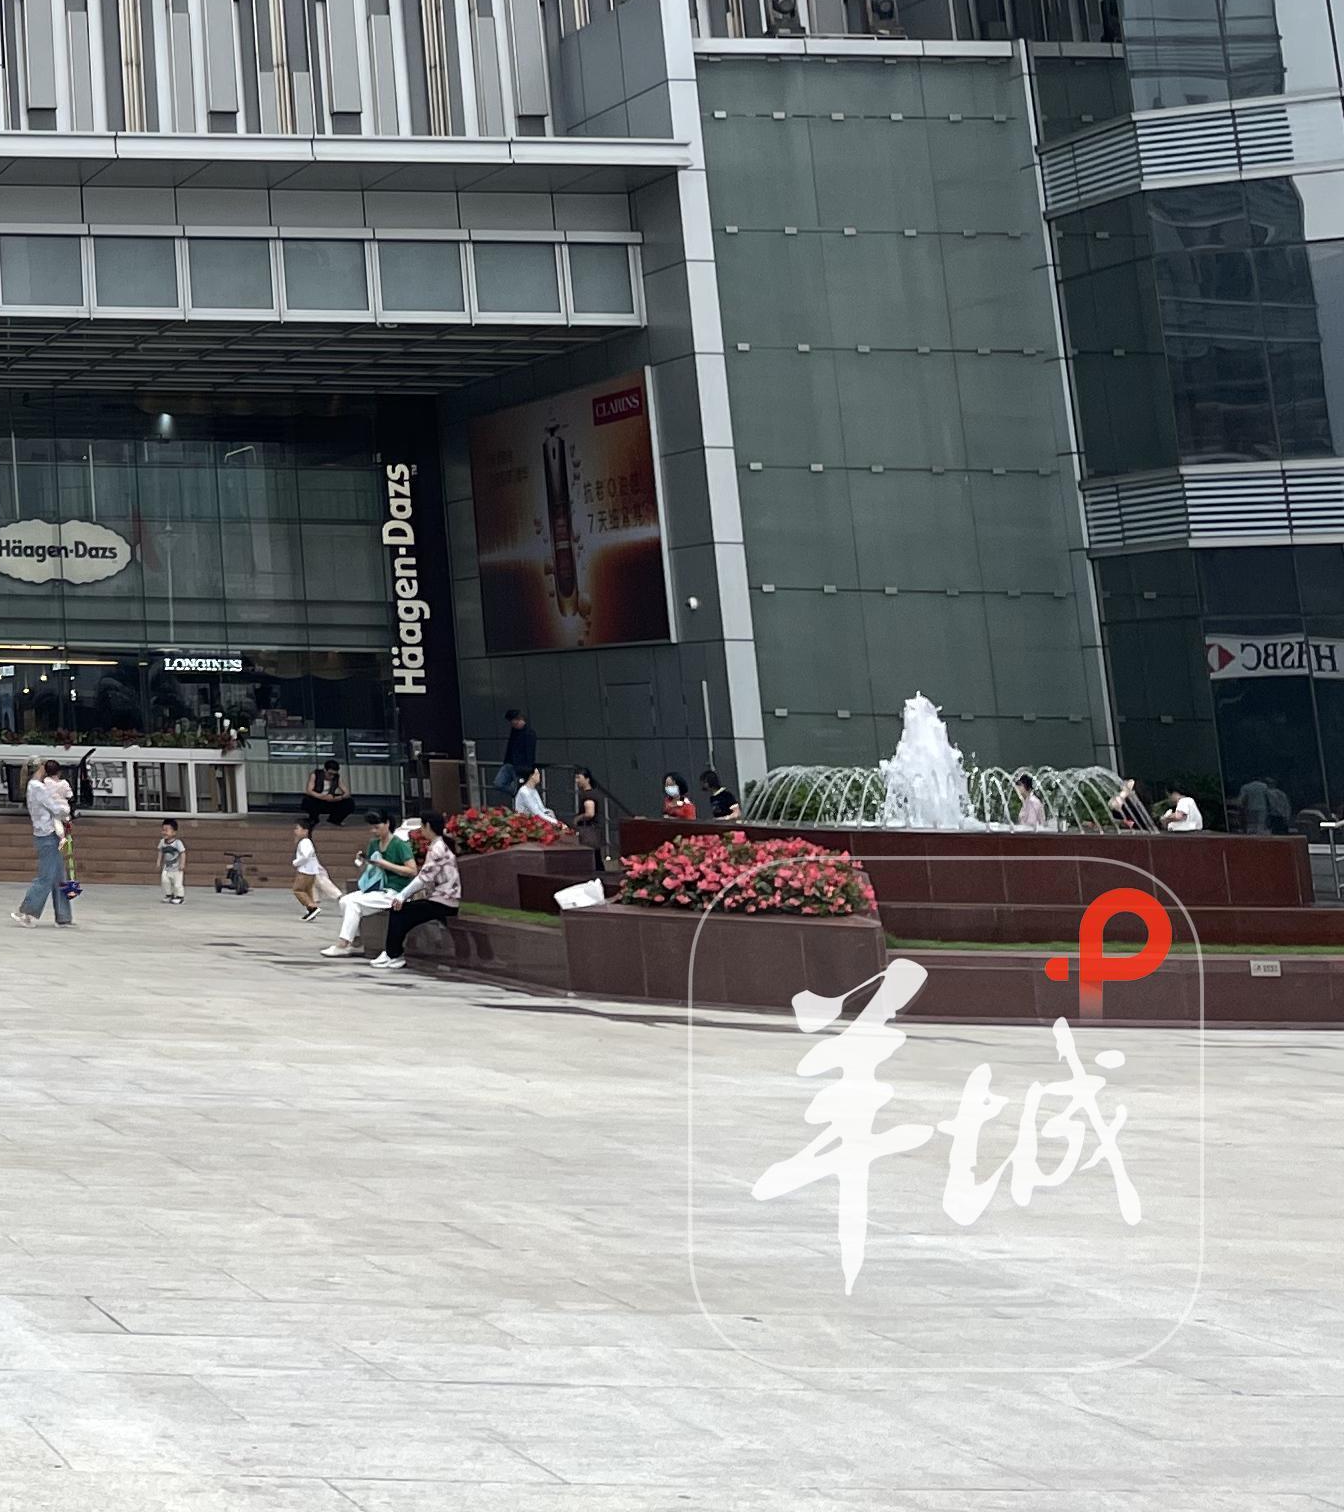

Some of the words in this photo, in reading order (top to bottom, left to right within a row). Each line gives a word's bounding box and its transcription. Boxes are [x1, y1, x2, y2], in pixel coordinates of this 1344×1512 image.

[596, 394, 640, 418] CLARINS
[382, 463, 431, 694] Häagen-Dazs
[163, 657, 243, 671] LONGINES
